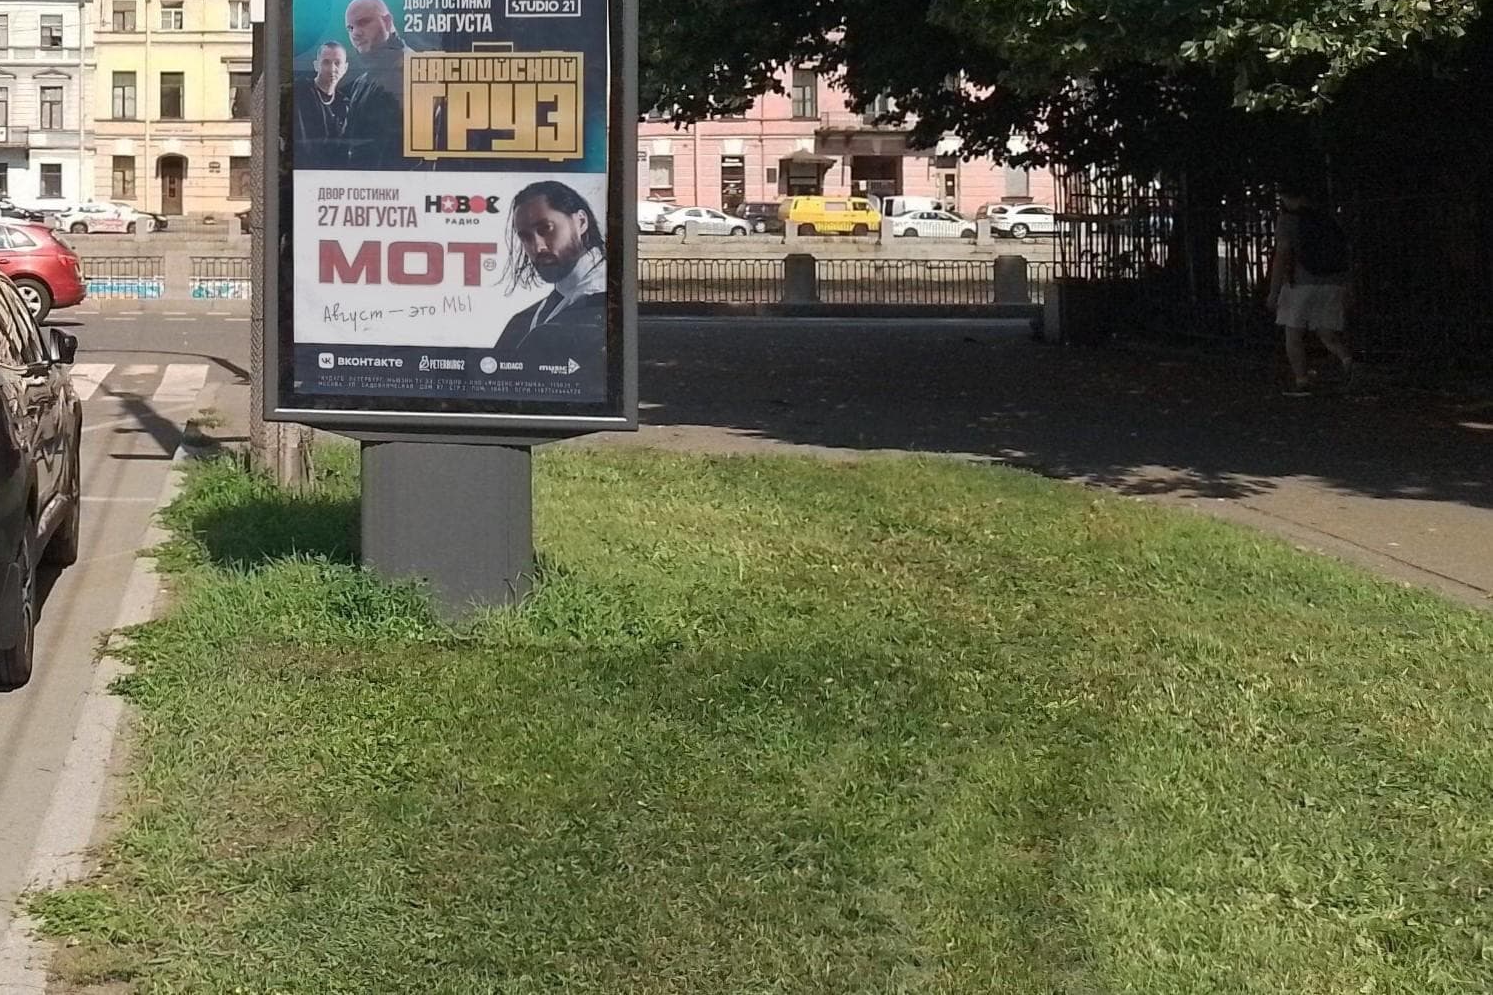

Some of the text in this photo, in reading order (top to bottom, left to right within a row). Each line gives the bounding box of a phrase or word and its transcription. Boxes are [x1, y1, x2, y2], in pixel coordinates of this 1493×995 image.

[511, 0, 575, 13] STUDIO 21
[403, 13, 493, 33] 25 АВГУСТА
[411, 58, 576, 82] КАСПИЙСКИЙ
[411, 82, 576, 151] ГРУЗ
[317, 187, 400, 201] ДВОР ГОСТИНКИ
[317, 206, 418, 228] 27 АВГУСТА
[445, 218, 480, 226] РАДИО
[318, 239, 498, 287] МОТ
[323, 302, 383, 332] Август
[408, 305, 436, 318] это
[442, 294, 473, 314] МЫ
